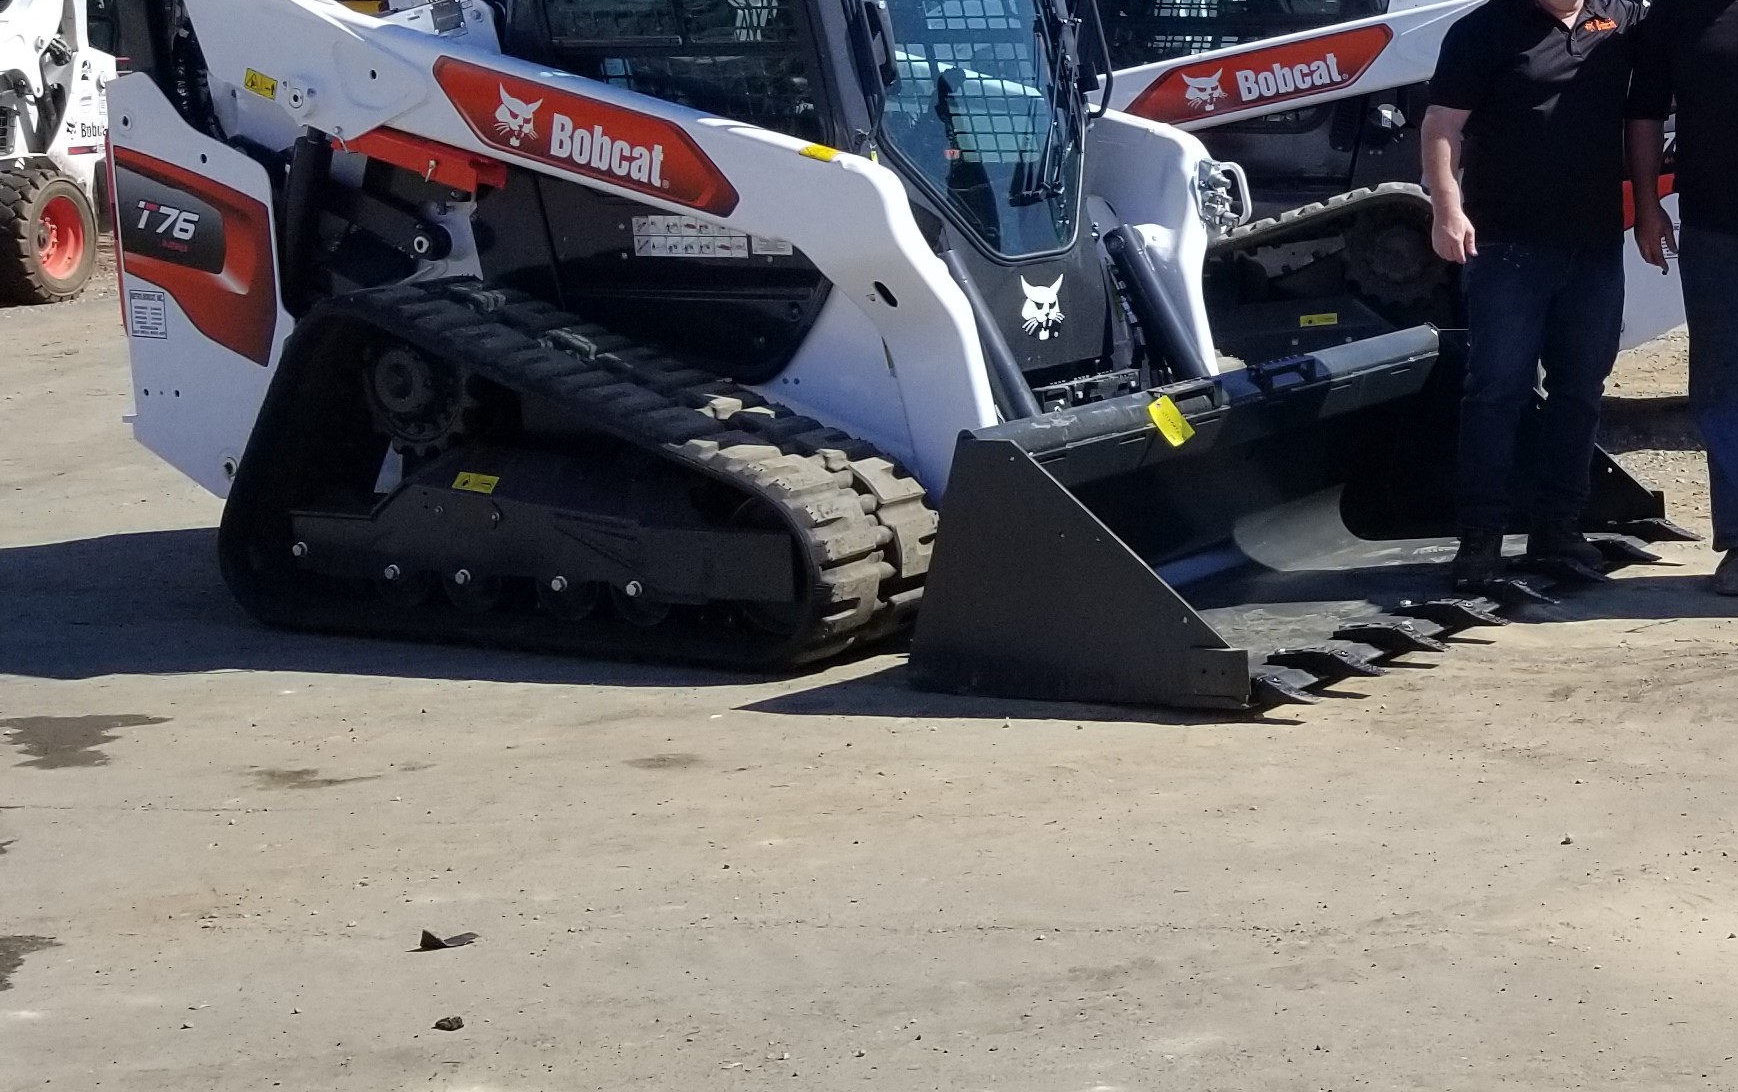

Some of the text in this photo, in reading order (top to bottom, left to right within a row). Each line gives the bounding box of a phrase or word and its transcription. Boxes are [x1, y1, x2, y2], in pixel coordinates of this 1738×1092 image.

[1236, 53, 1342, 102] Bobcat
[81, 122, 107, 138] Bobca
[550, 112, 664, 188] Bobcat
[137, 200, 200, 240] T76
